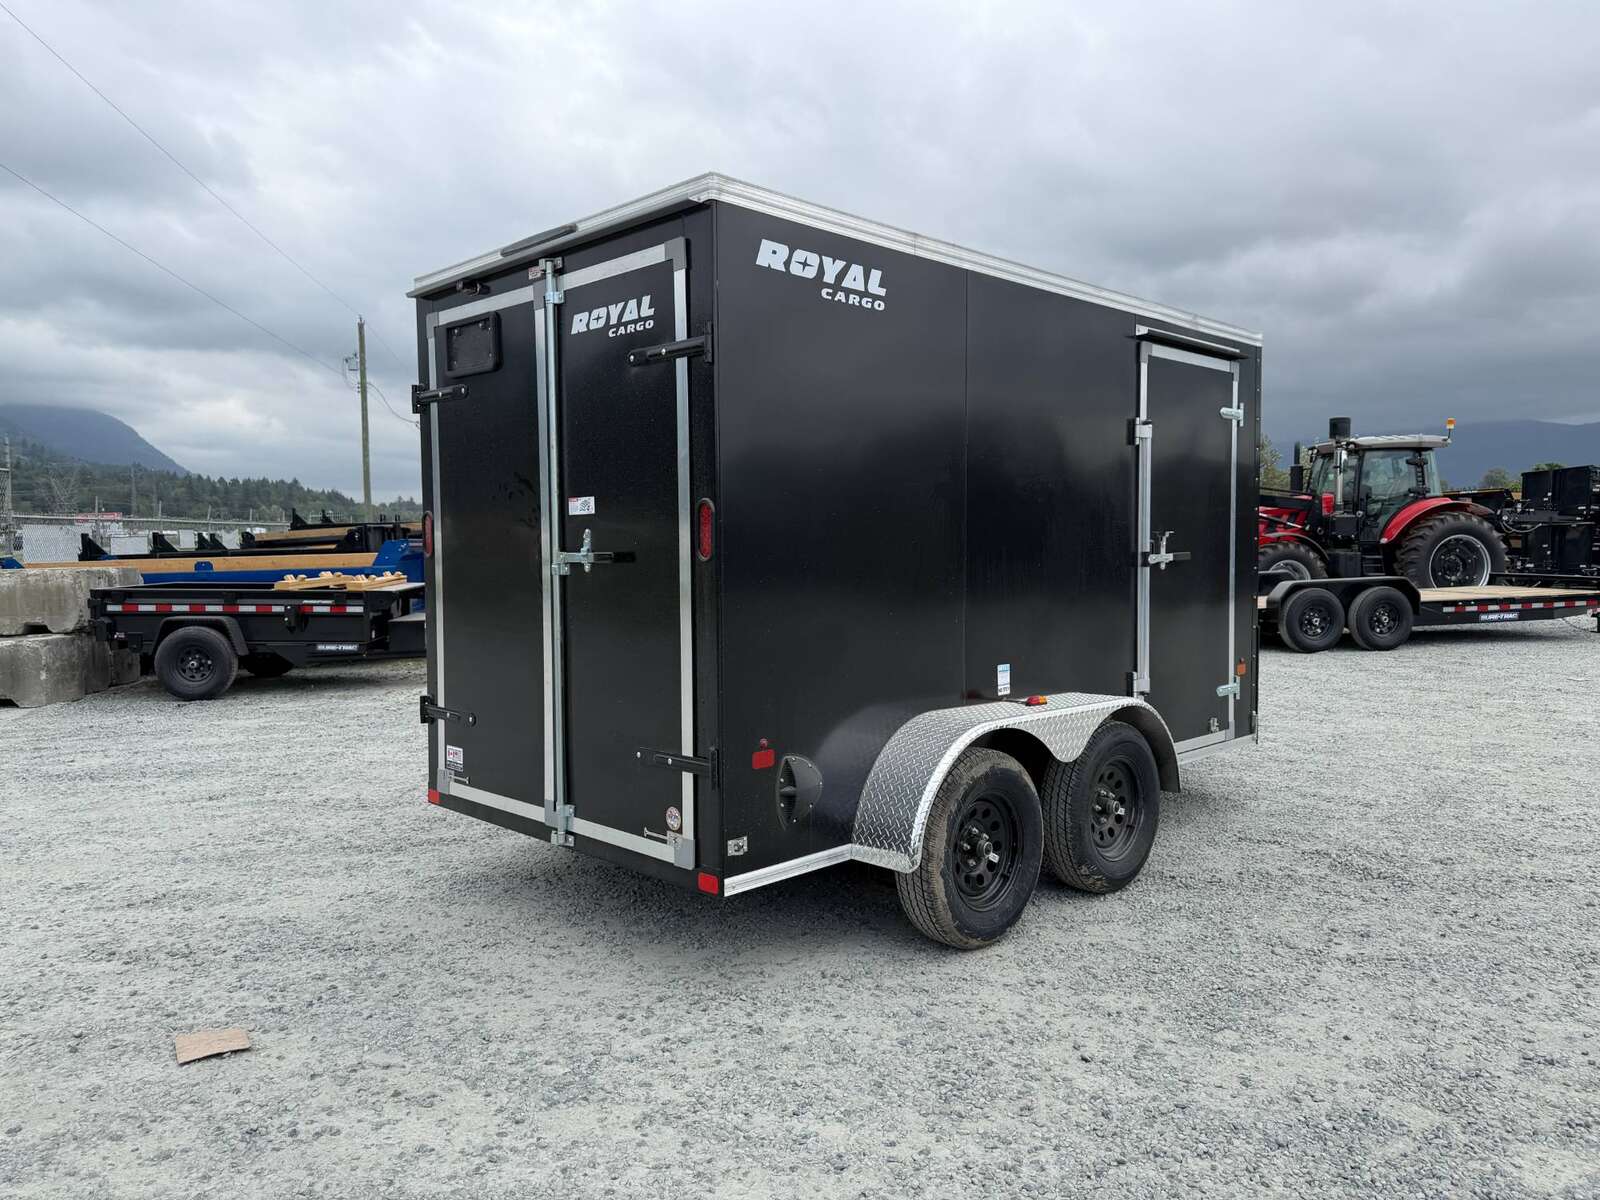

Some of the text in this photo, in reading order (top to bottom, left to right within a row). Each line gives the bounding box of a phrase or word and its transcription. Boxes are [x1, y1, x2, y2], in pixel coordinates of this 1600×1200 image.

[755, 238, 887, 297] ROYAL
[571, 295, 655, 335] ROYAL
[821, 287, 885, 311] CARGO
[608, 320, 654, 337] CARGO
